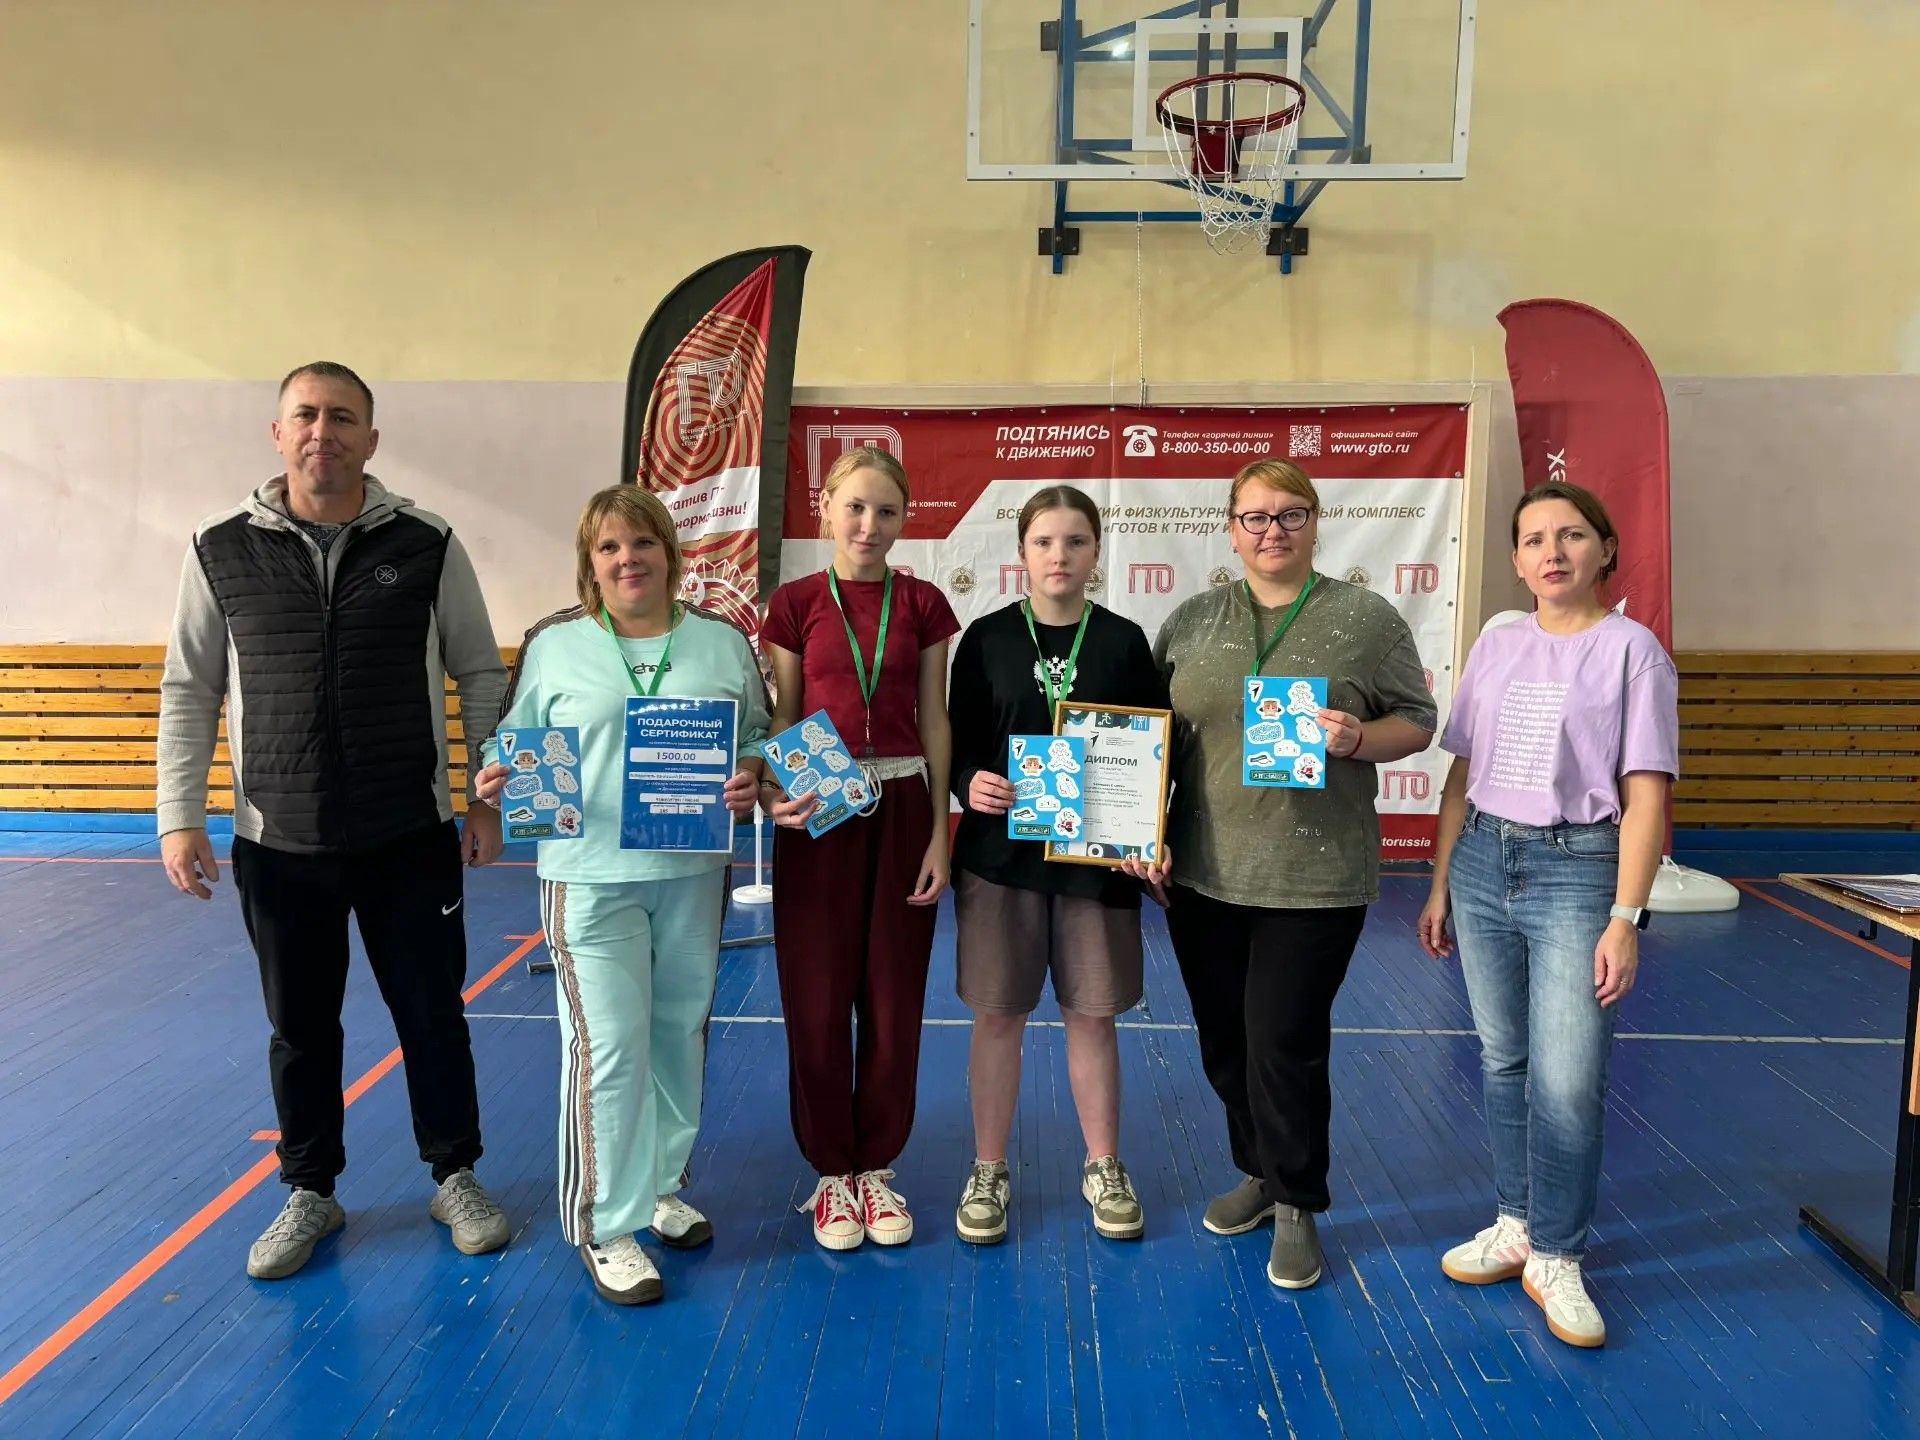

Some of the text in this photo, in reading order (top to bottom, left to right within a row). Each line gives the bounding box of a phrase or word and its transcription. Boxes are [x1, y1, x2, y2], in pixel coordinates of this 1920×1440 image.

[995, 425, 1111, 444] ПОДТЯНИСЬ
[1162, 431, 1274, 440] Телефон «горячей линии»
[1330, 431, 1393, 439] официальный
[996, 446, 1095, 461] К ДВИЖЕНИЮ
[1161, 442, 1270, 454] 8-800-350-00-00
[1330, 443, 1410, 456] www.gto.ru
[668, 492, 708, 511] атив
[711, 501, 747, 518] изни!
[1124, 507, 1226, 518] ФИЗКУЛЬТУРН
[1347, 506, 1426, 518] КОМПЛЕКС
[1103, 522, 1157, 533] «ГОТОВ
[1161, 522, 1170, 533] К
[1174, 522, 1220, 536] ТРУДУ
[1128, 563, 1175, 594] ГТО
[1394, 563, 1440, 594] ГТО
[637, 718, 723, 728] ПОДАРОЧНЫЙ
[640, 729, 719, 739] СЕРТИФИКАТ
[656, 752, 696, 762] 1500,00
[1084, 754, 1138, 766] ДИПЛОМ
[1382, 770, 1430, 800] ГТО
[1381, 837, 1431, 847] torussia
